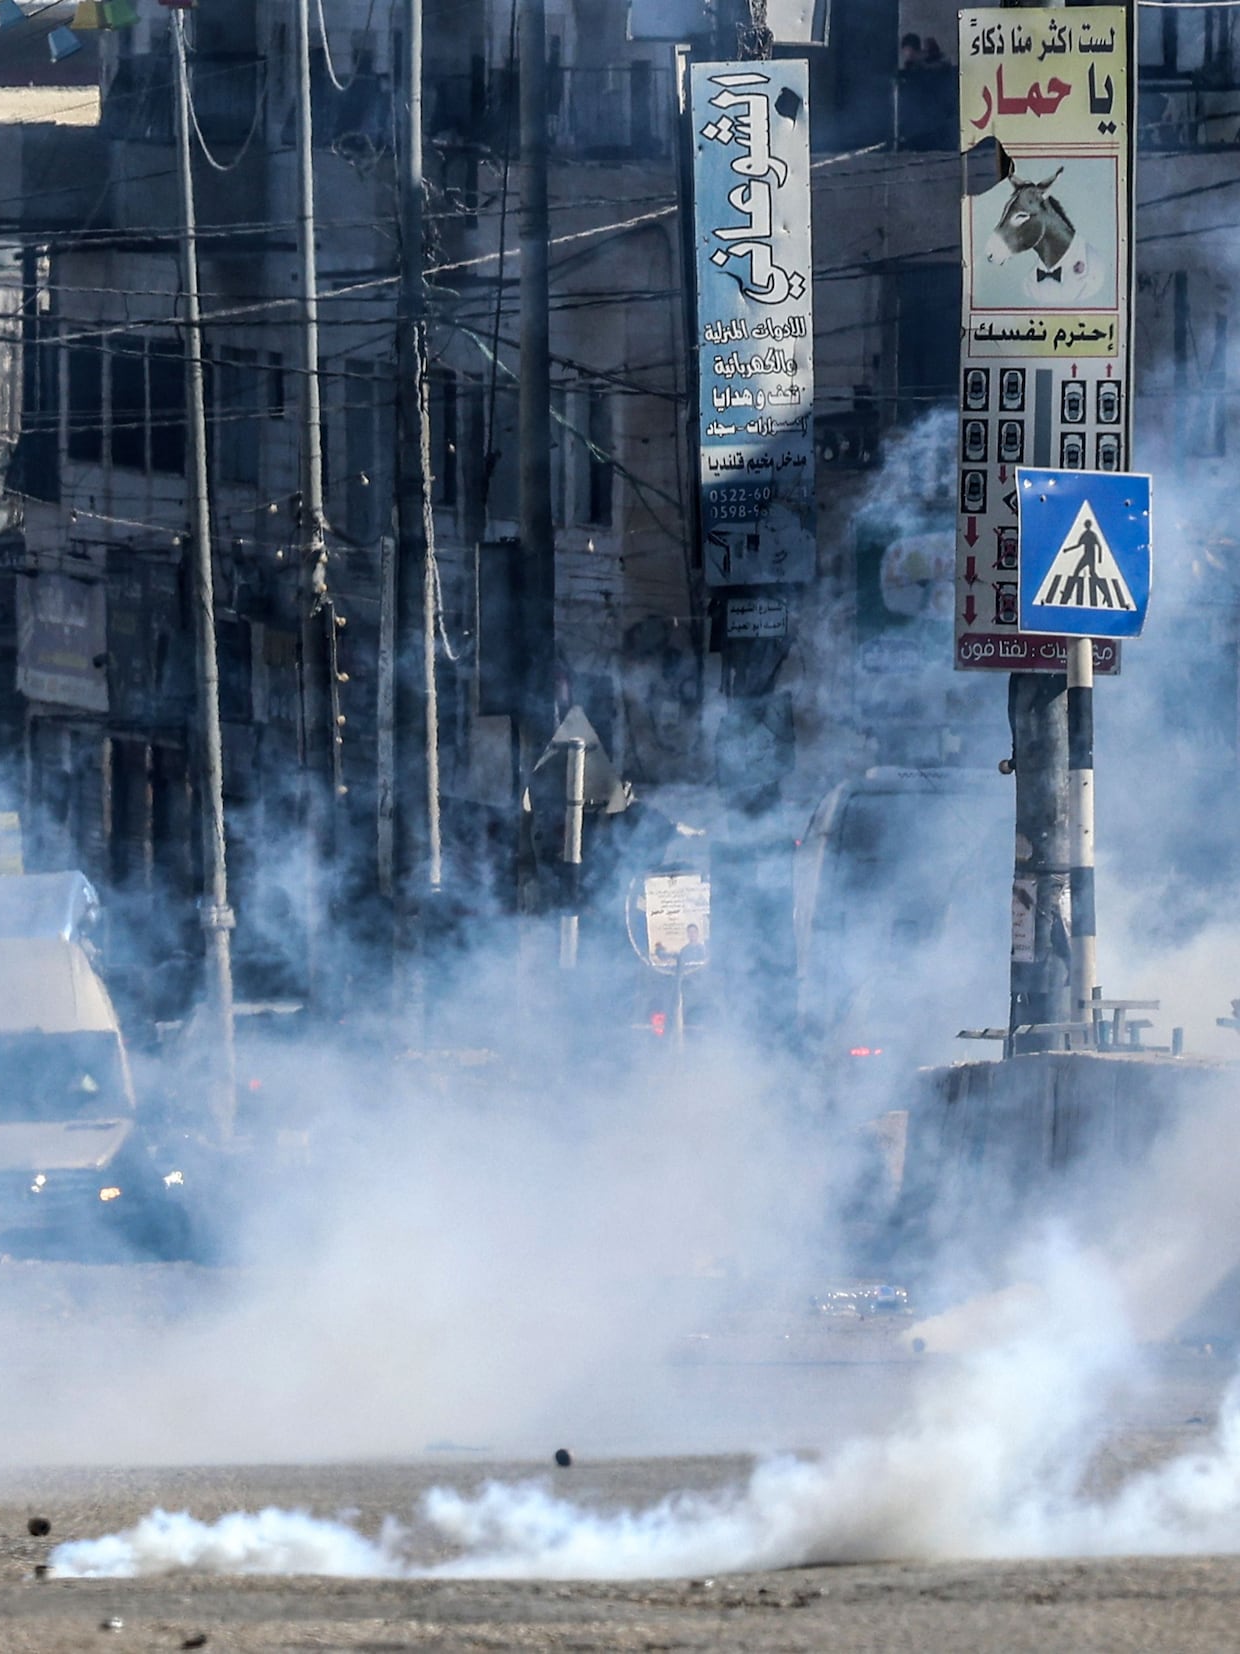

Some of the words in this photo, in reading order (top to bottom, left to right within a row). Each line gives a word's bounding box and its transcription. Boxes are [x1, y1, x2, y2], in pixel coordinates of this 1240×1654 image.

[1012, 24, 1032, 54] منا
[1079, 23, 1116, 53] لست
[970, 63, 1072, 130] حمار
[1088, 62, 1117, 135] يا
[703, 318, 748, 345] المنزلية
[974, 319, 1047, 341] نفسك
[1053, 322, 1114, 351] إحترم
[713, 347, 798, 379] والكهربائية
[711, 385, 753, 413] هدايا
[752, 388, 766, 412] و
[705, 418, 736, 438] سجاد
[708, 452, 745, 477] قلنديا
[747, 453, 774, 475] مخيم
[775, 451, 807, 472] مدخل
[961, 638, 995, 661] فون
